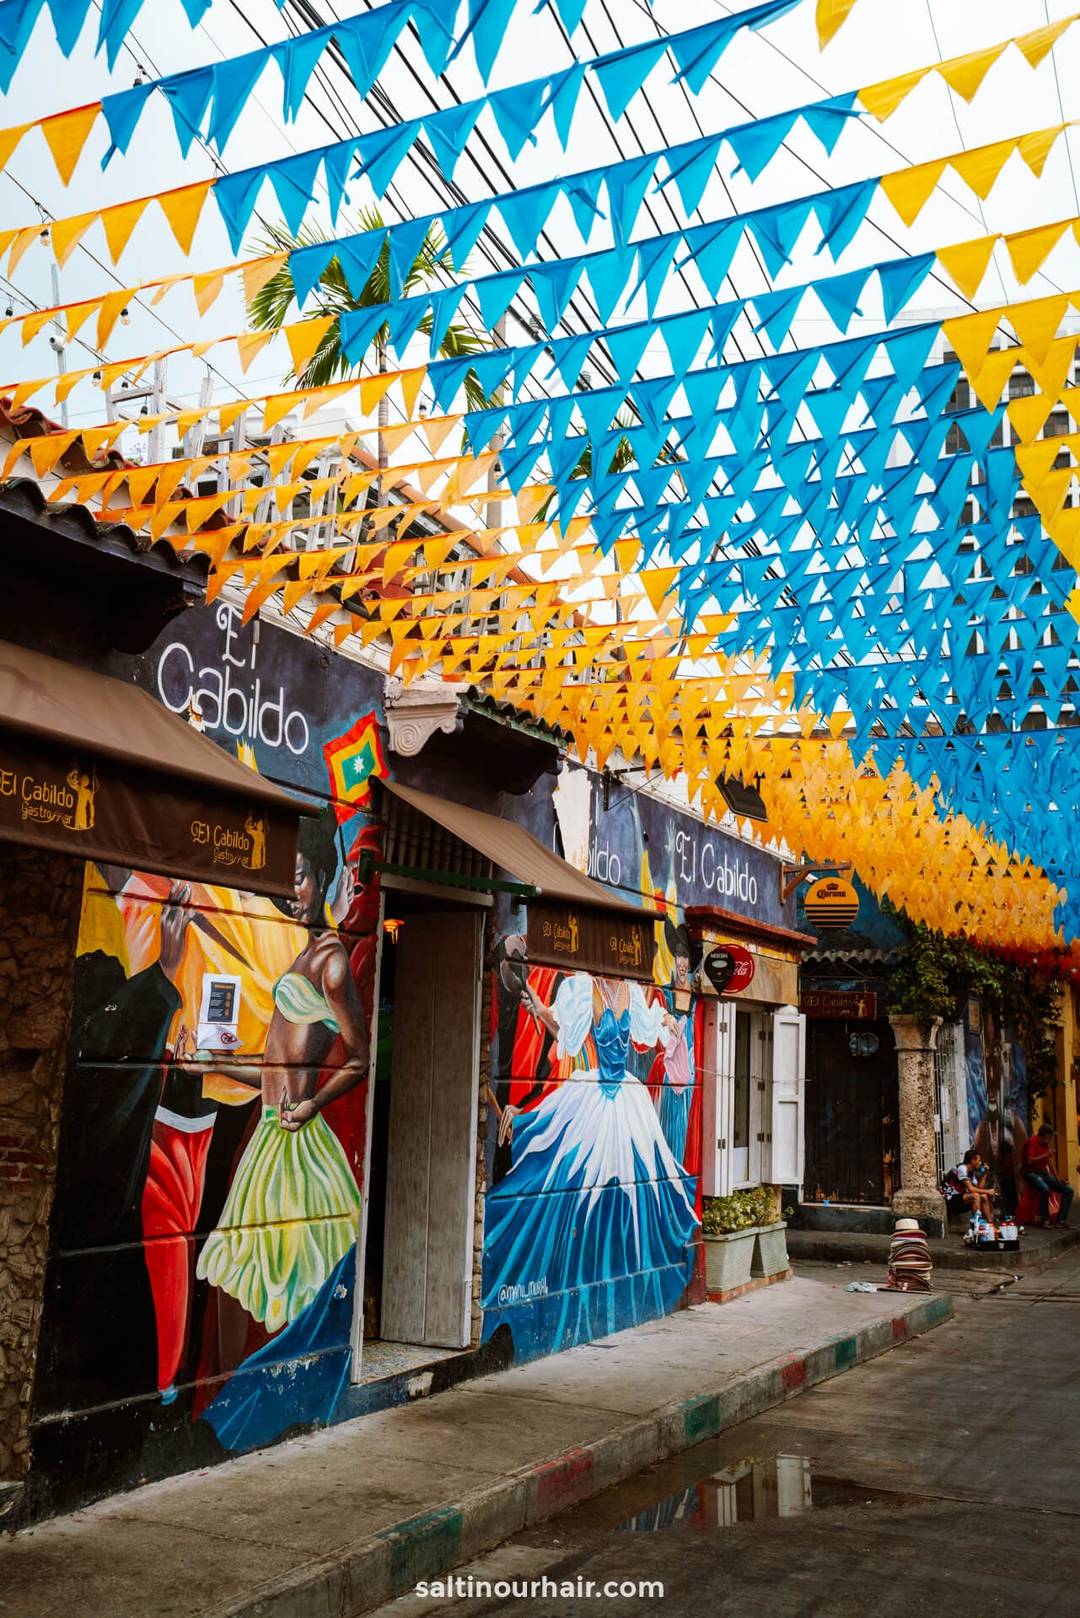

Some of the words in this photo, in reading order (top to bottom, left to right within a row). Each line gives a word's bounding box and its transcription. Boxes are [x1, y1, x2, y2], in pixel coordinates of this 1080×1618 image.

[158, 642, 309, 755] Cabildo
[0, 768, 17, 796] El
[21, 776, 74, 809] Cabildo
[190, 820, 210, 844] El
[213, 825, 250, 851] Cabildo
[675, 831, 696, 884] El
[701, 843, 758, 905] Cabildo
[816, 889, 846, 900] Corona
